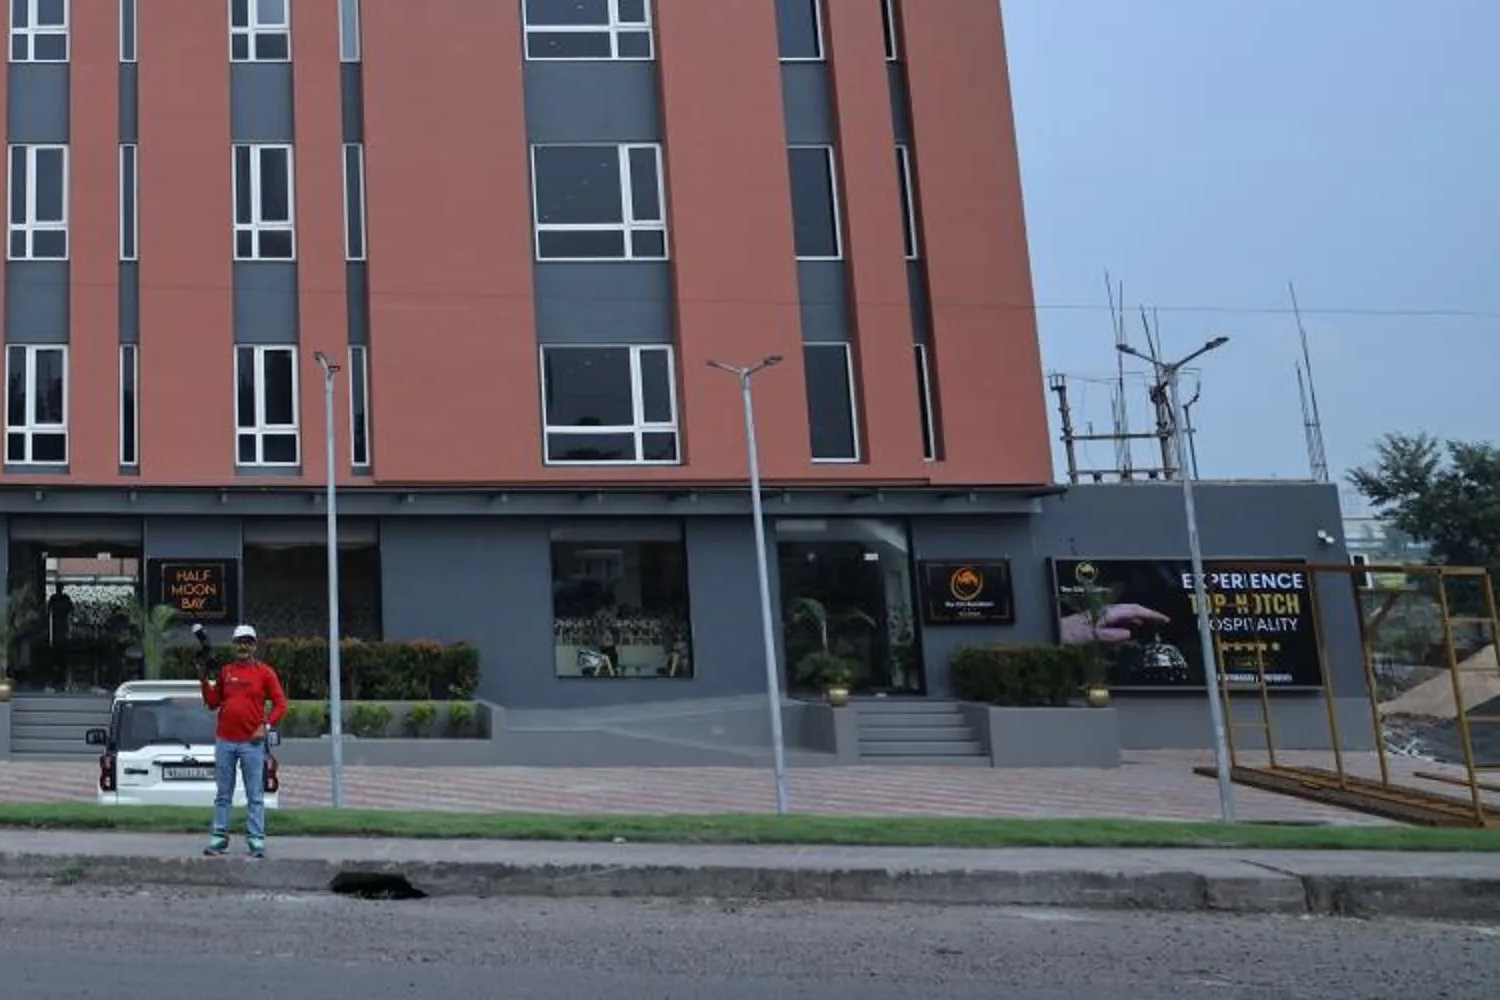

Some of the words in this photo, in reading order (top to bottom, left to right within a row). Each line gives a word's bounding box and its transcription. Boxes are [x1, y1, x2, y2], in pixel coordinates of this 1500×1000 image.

[176, 569, 211, 581] HALF
[171, 583, 217, 596] MOON
[181, 598, 207, 609] BAY
[1197, 617, 1298, 631] OSPIALITY
